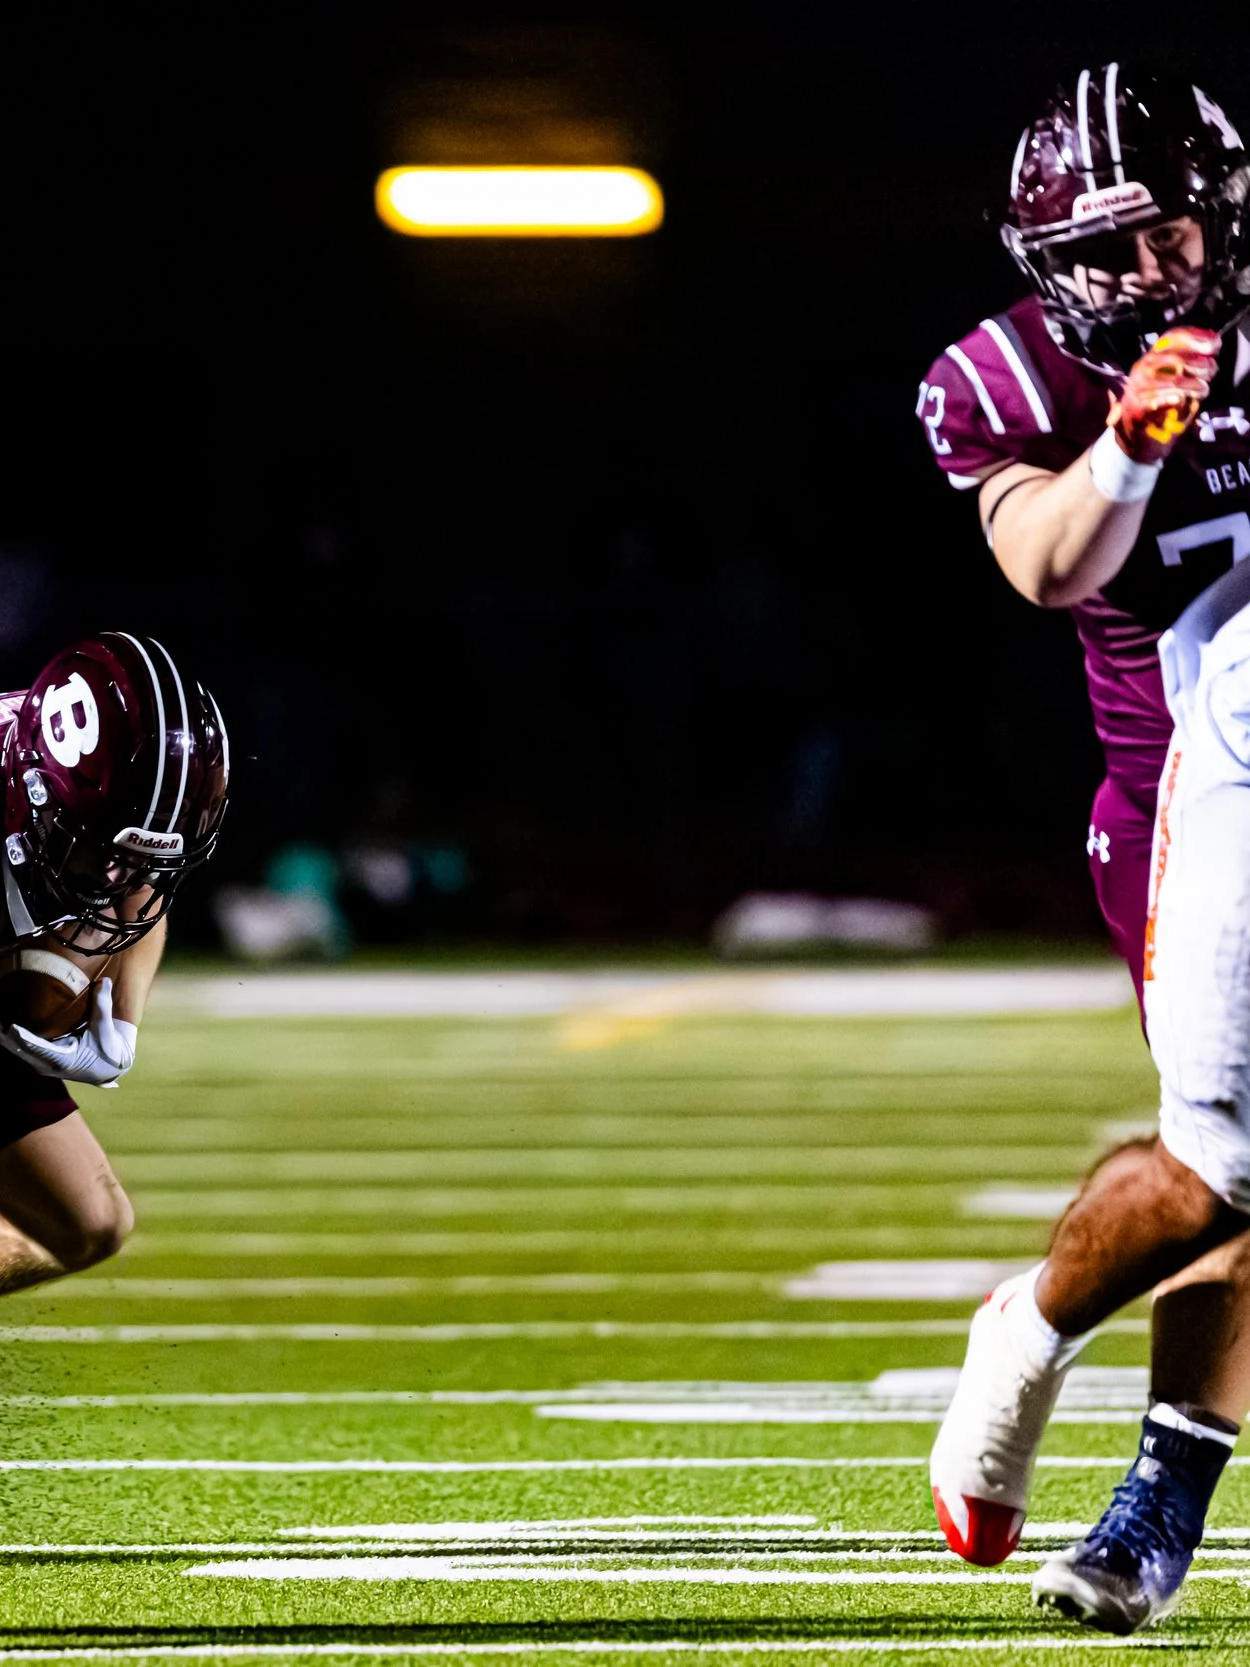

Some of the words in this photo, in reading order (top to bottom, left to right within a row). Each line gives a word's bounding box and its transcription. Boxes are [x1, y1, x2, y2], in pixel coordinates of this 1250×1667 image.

[1205, 459, 1250, 495] BEA
[40, 672, 101, 768] B
[127, 832, 180, 850] Riddell
